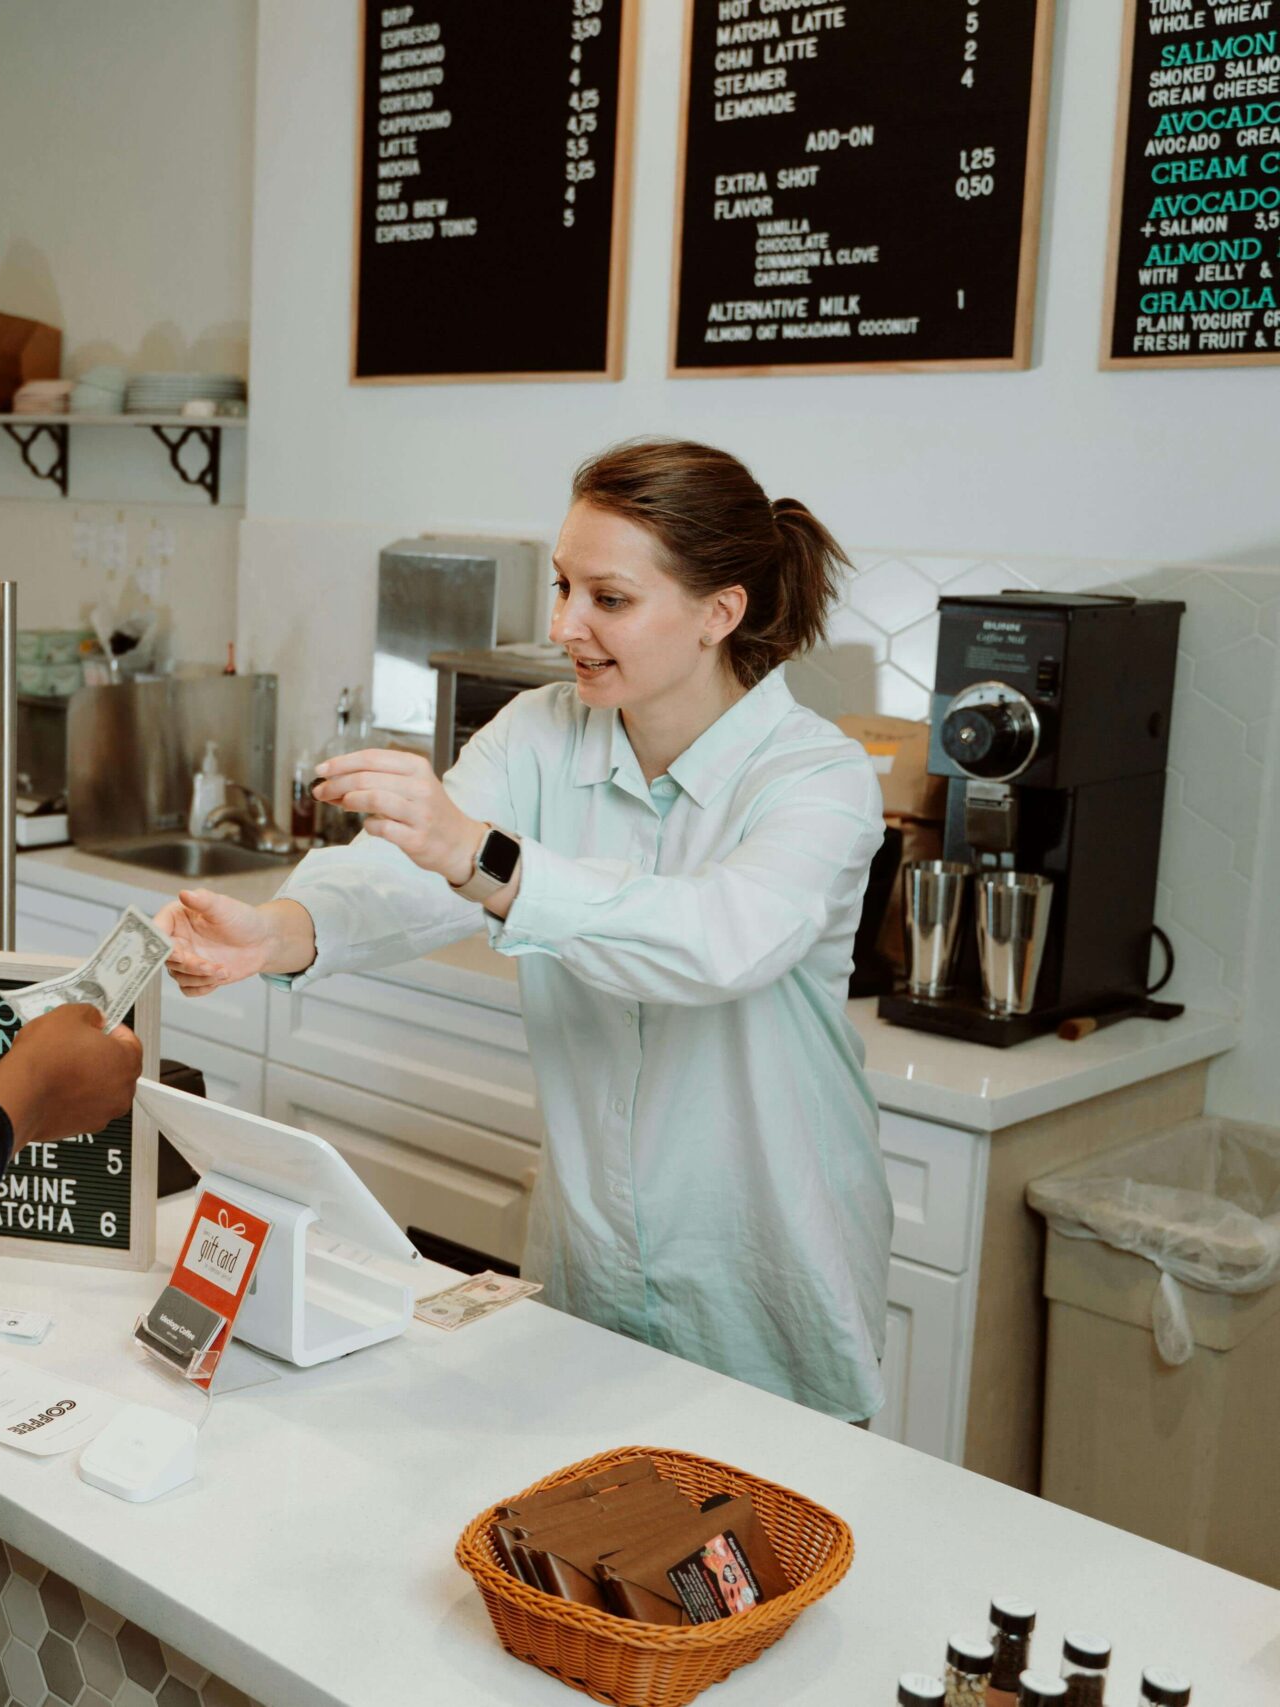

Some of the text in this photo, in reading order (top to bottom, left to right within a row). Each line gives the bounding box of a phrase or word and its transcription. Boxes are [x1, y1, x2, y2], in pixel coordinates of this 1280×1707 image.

[719, 0, 750, 21] HOT
[1149, 2, 1272, 35] WHOLE WHEAT
[1150, 0, 1192, 15] TUNA
[717, 7, 847, 46] MATCHA LATTE
[965, 12, 979, 33] 5
[381, 23, 440, 49] ESPRESSO
[571, 45, 581, 63] 4
[715, 37, 818, 71] CHAI LATTE
[964, 40, 977, 61] 2
[1160, 31, 1277, 67] SALMON
[569, 68, 581, 86] 4
[715, 68, 786, 96] STEAMER
[961, 68, 973, 88] 4
[1149, 64, 1215, 88] SMOKED
[1148, 76, 1280, 108] CREAM CHEESE
[715, 92, 796, 121] LEMONADE
[1154, 102, 1280, 136] AVOCADO
[379, 136, 417, 157] LATTE
[805, 126, 874, 152] ADD-ON
[1145, 133, 1220, 156] AVOCADO
[377, 159, 420, 179] MOCHA
[959, 147, 995, 173] 1,25
[1151, 154, 1248, 184] CREAM
[715, 166, 819, 195] EXTRA SHOT
[956, 175, 993, 200] 0,50
[565, 185, 576, 203] 4
[1148, 187, 1280, 218] AVOCADO
[376, 199, 448, 221] COLD BREW
[563, 208, 575, 227] 5
[715, 197, 772, 220] FLAVOR
[376, 217, 477, 243] ESPRESSO TONIC
[757, 219, 810, 236] VANILLA
[1159, 215, 1228, 236] SALMON
[756, 233, 829, 253] CHOCOLATE
[1144, 238, 1262, 266] ALMOND
[755, 246, 879, 270] CINNAMON & CLOVE
[754, 270, 811, 287] CARAMEL
[1139, 261, 1272, 285] WITH JELLY &
[708, 295, 860, 322] ALTERNATIVE MILK
[957, 289, 964, 309] 1
[1140, 286, 1276, 314] GRANOLA
[705, 318, 919, 342] ALMOND OAT MACADAMIA COCONUT
[1137, 315, 1184, 333] PLAIN
[1191, 311, 1253, 330] YOGURT
[1133, 333, 1190, 352] FRESH
[1199, 331, 1247, 349] FRUIT
[1255, 330, 1267, 347] &
[983, 620, 1021, 632] BUNN
[107, 1149, 122, 1175] 5
[100, 1211, 116, 1237] 6
[198, 1235, 219, 1264] gift
[217, 1249, 241, 1274] card
[159, 1313, 180, 1333] Ideology
[178, 1323, 196, 1340] Coffee
[6, 1399, 77, 1436] COFFEE
[735, 1550, 746, 1568] Vegan
[744, 1568, 759, 1597] Chocolate
